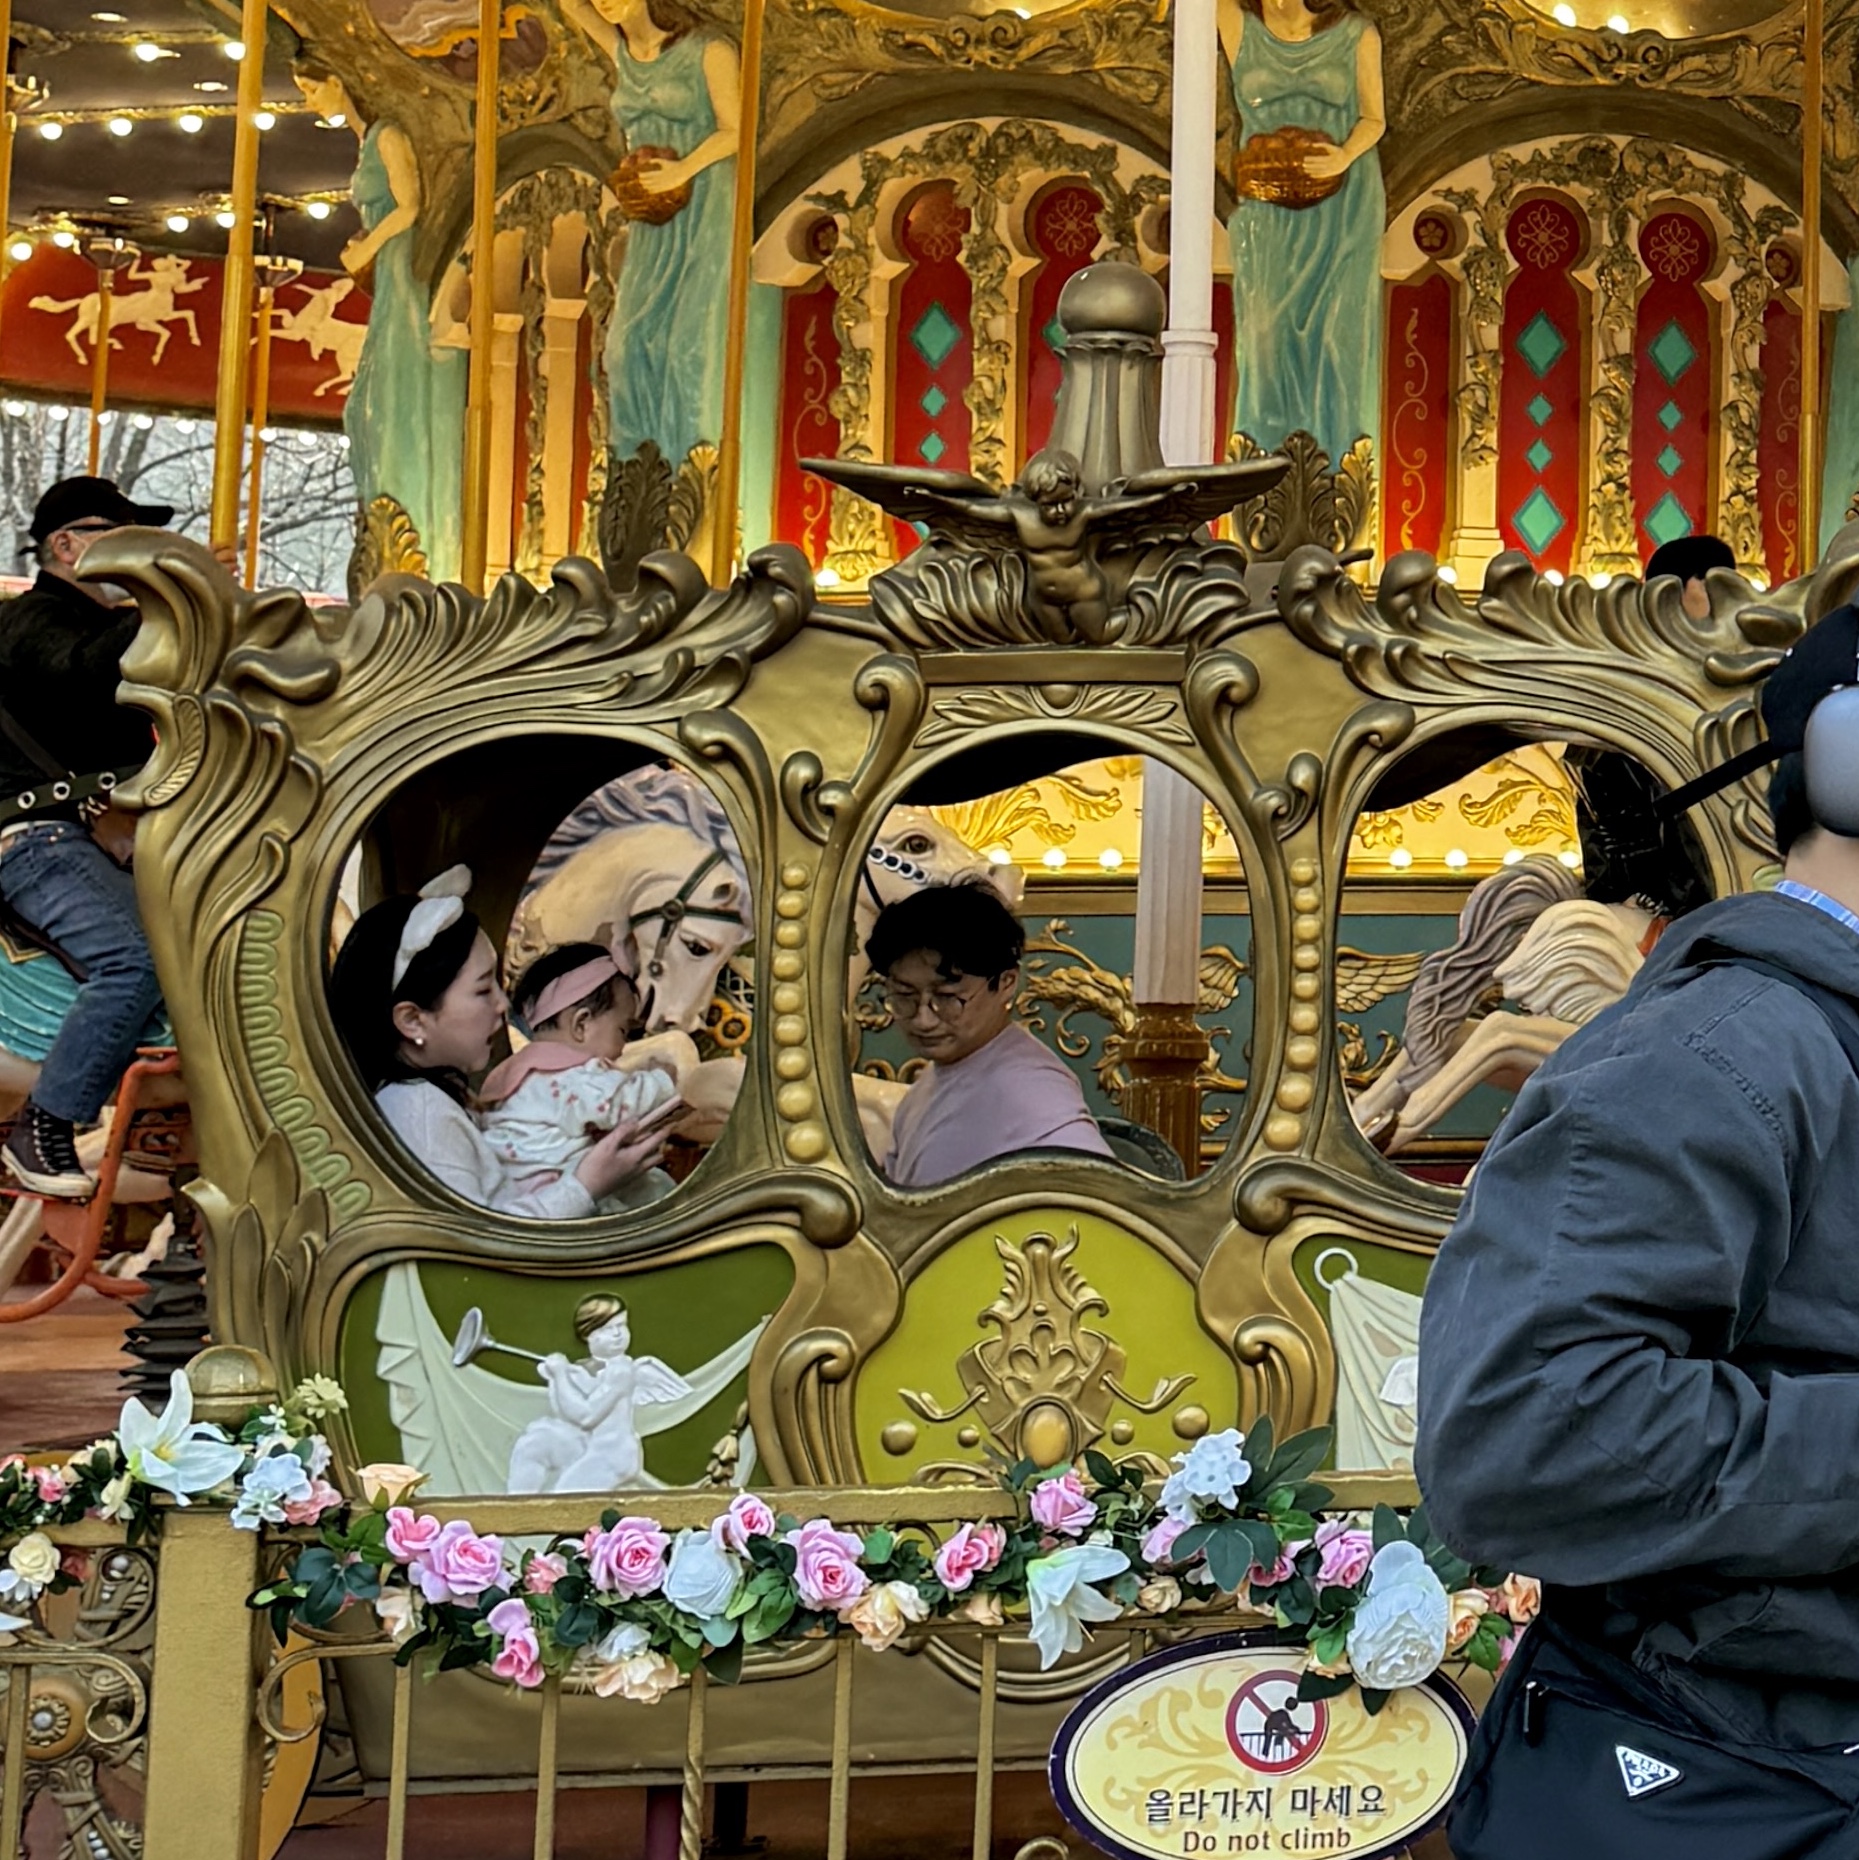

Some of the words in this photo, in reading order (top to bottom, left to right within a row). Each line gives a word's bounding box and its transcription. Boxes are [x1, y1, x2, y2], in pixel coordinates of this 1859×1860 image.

[1145, 1786, 1274, 1824] 올라가지
[1290, 1784, 1387, 1820] 마세요
[1183, 1830, 1217, 1853] Do
[1228, 1830, 1270, 1851] not
[1280, 1826, 1352, 1850] climb
